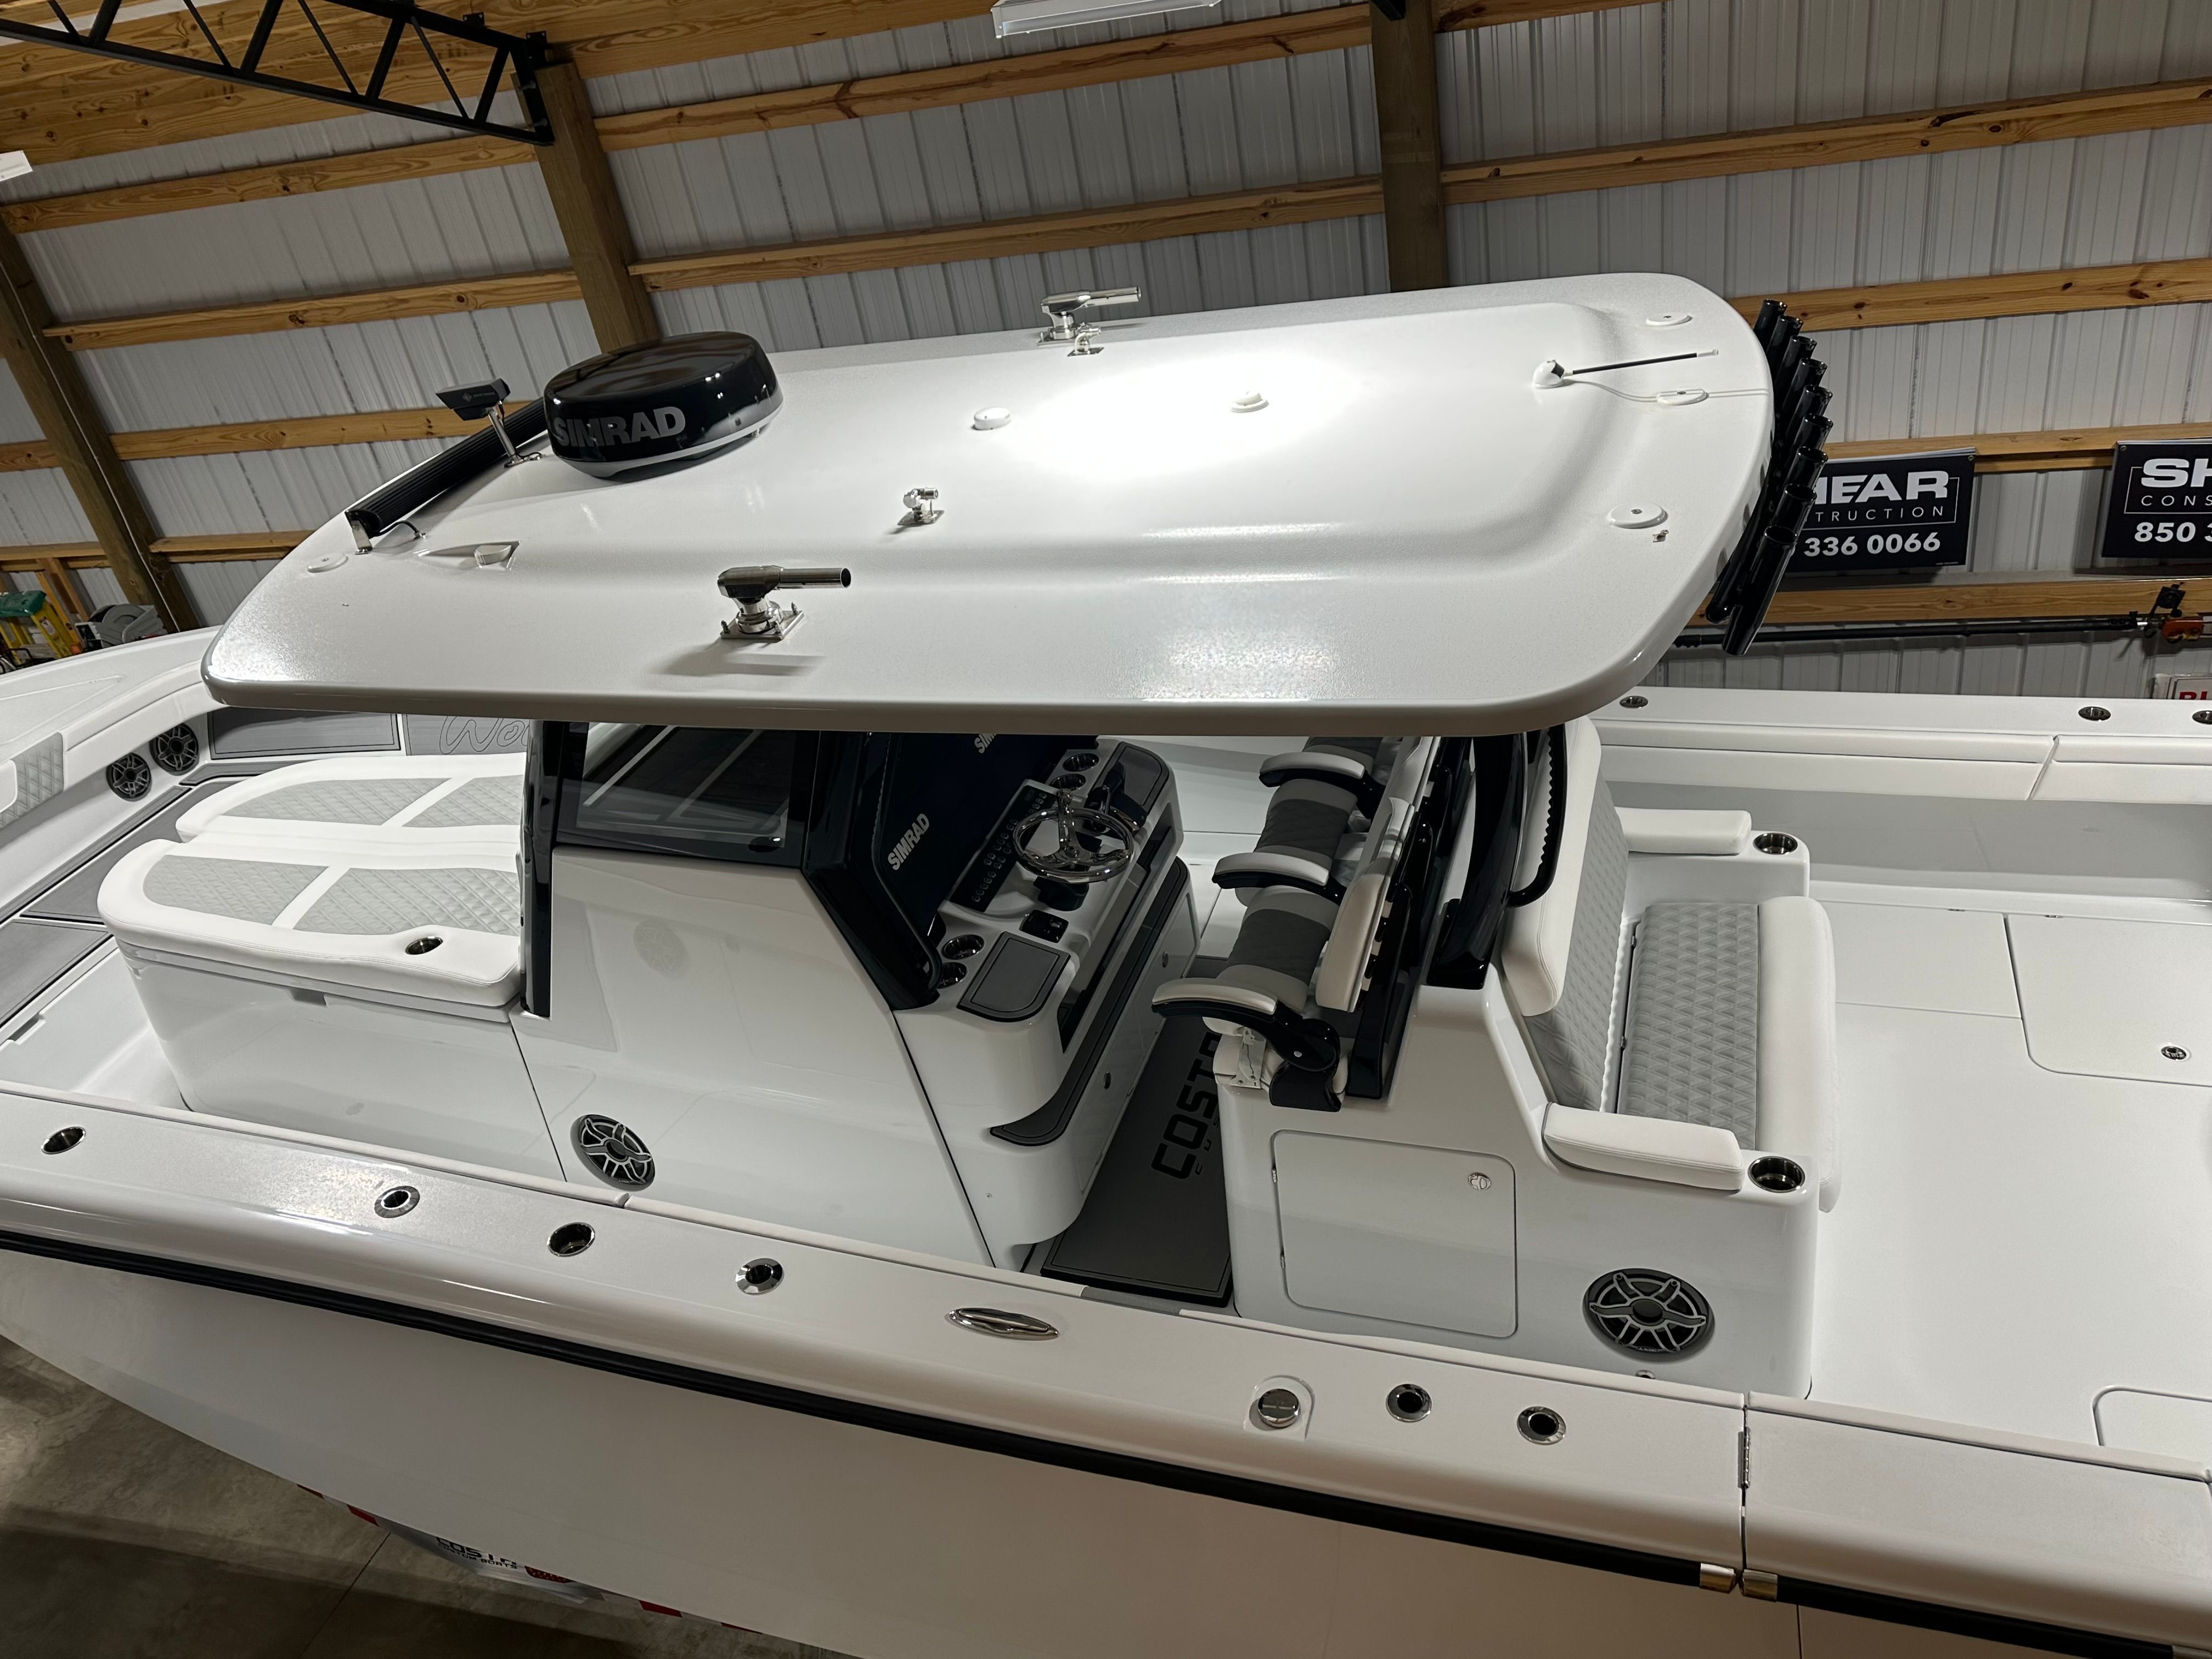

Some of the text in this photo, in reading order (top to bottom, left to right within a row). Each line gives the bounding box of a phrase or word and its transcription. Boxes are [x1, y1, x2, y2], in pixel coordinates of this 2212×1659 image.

[553, 407, 686, 447] SIMRAD
[1804, 532, 1940, 557] 336 0066
[2135, 522, 2196, 542] 850
[974, 733, 996, 754] SIM
[888, 814, 929, 870] SIMRAD
